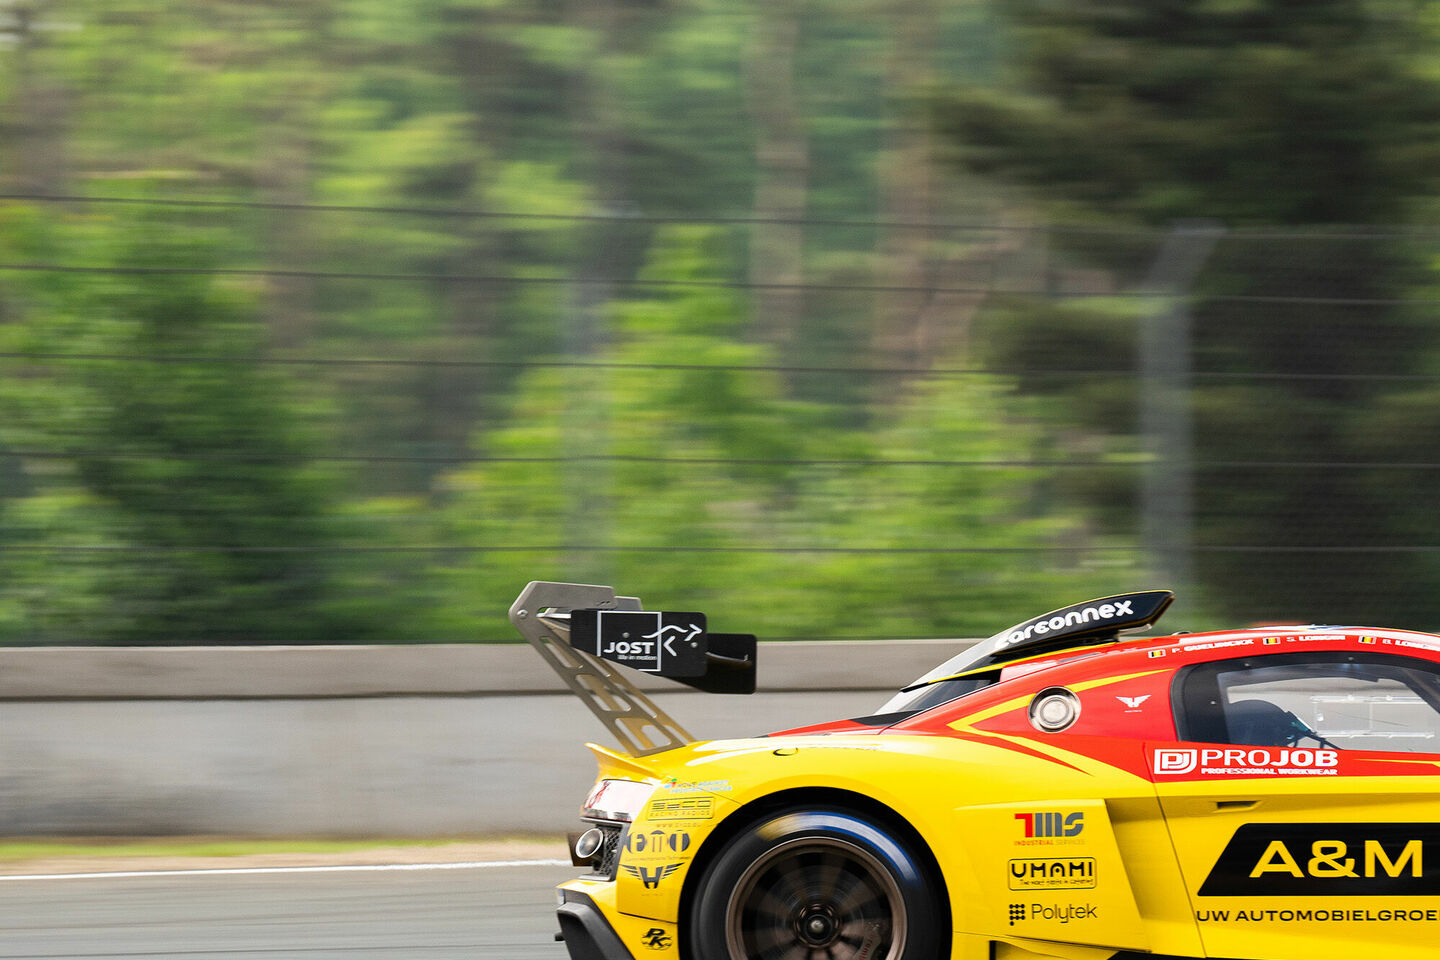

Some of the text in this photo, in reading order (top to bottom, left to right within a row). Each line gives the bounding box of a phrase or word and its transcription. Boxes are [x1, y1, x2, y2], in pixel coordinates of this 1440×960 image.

[994, 600, 1134, 649] carconnex
[603, 641, 654, 654] JOST
[1201, 749, 1338, 767] PROJOB
[1278, 768, 1338, 776] WORKWEAR
[1249, 840, 1423, 878] A&M
[1011, 862, 1093, 878] UMAMI
[1031, 903, 1098, 923] Polytek
[1197, 910, 1229, 921] UW
